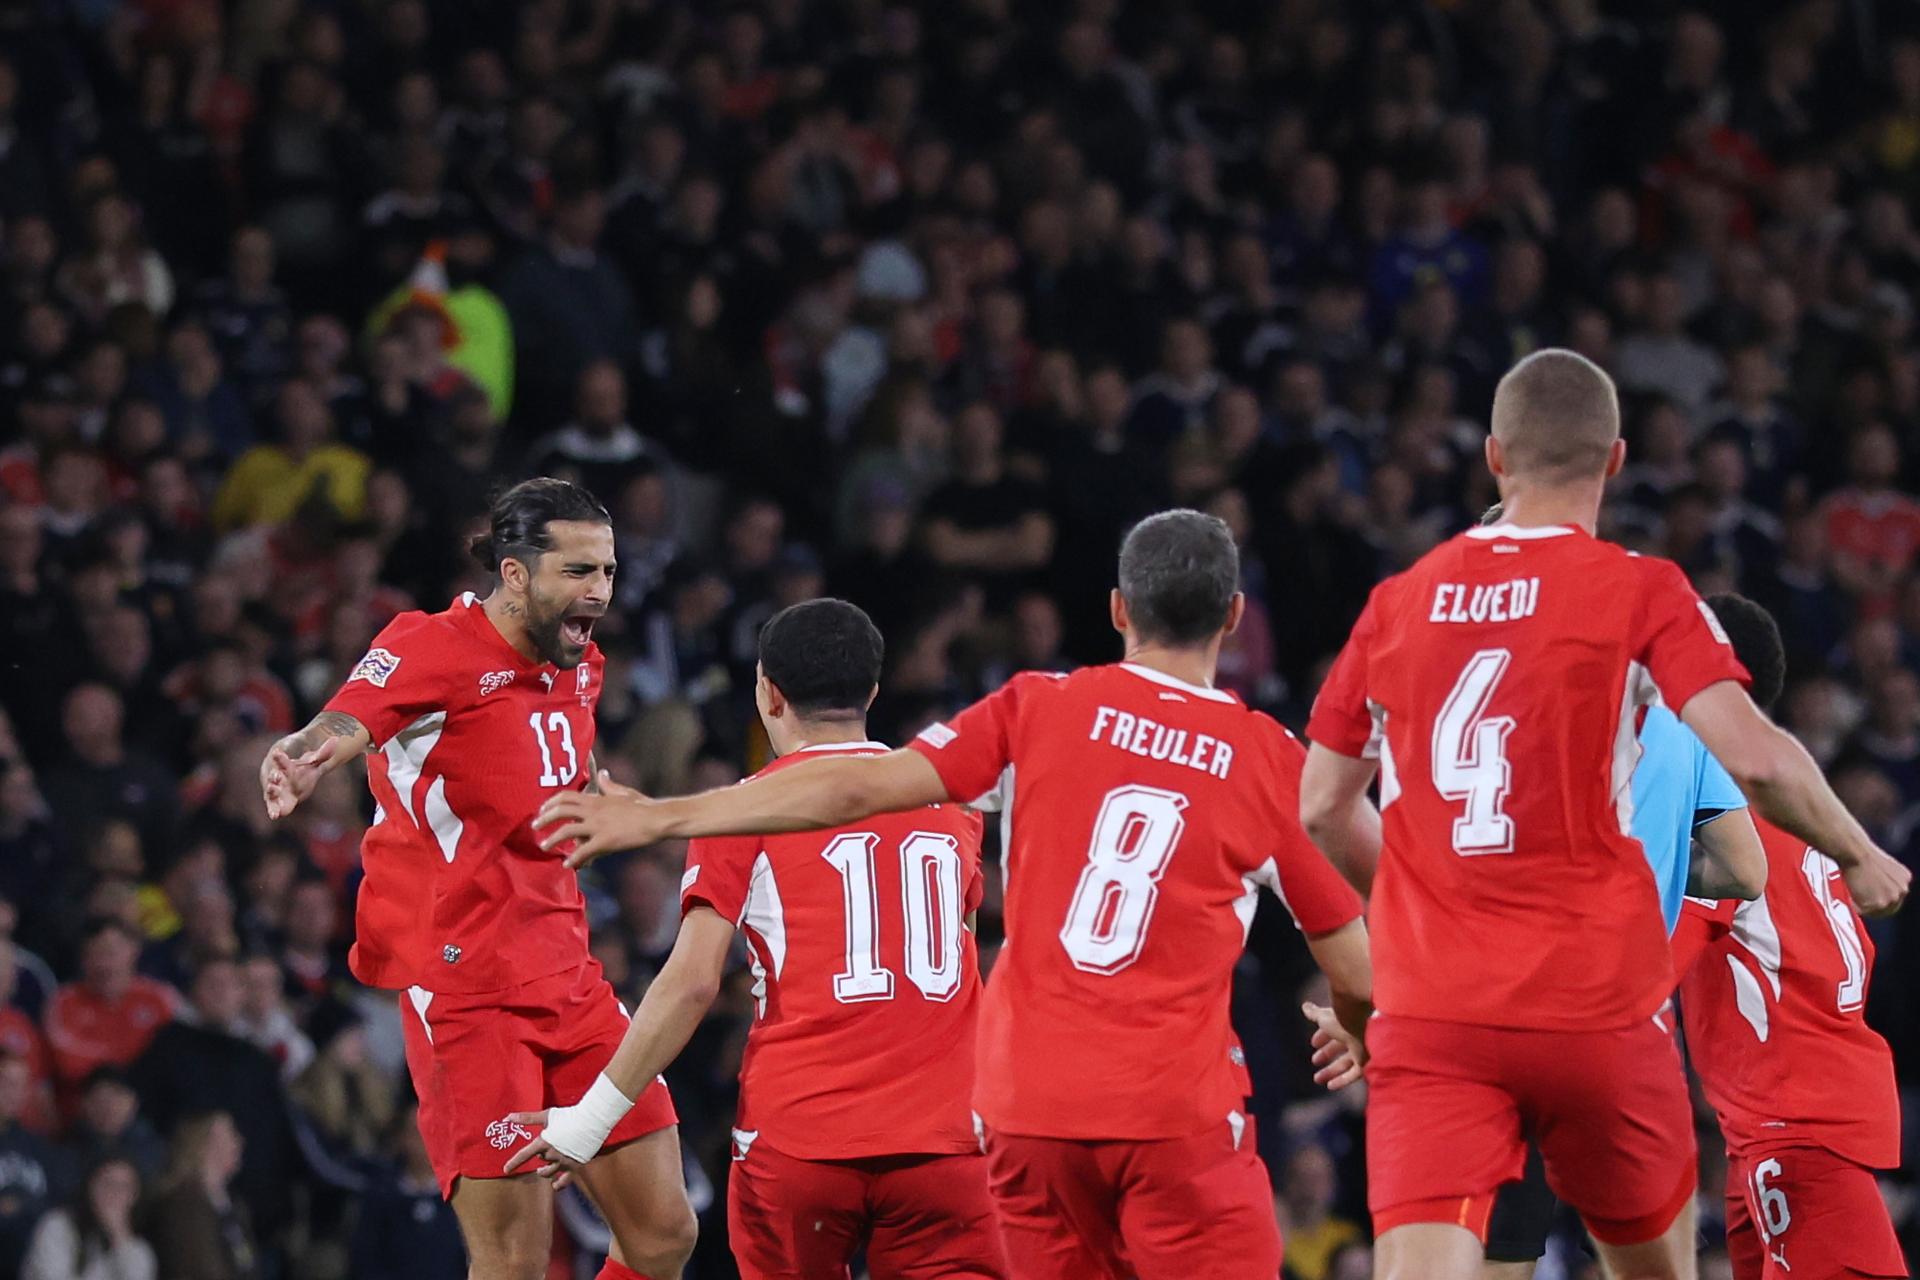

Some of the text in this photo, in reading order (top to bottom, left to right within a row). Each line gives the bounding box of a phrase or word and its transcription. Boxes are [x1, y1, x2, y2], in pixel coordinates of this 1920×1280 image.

[1429, 577, 1540, 623] ELVEDI
[529, 711, 578, 787] 13
[1089, 706, 1234, 780] FREULER
[1431, 648, 1517, 857] 4
[820, 831, 963, 1003] 10
[1058, 783, 1191, 977] 8
